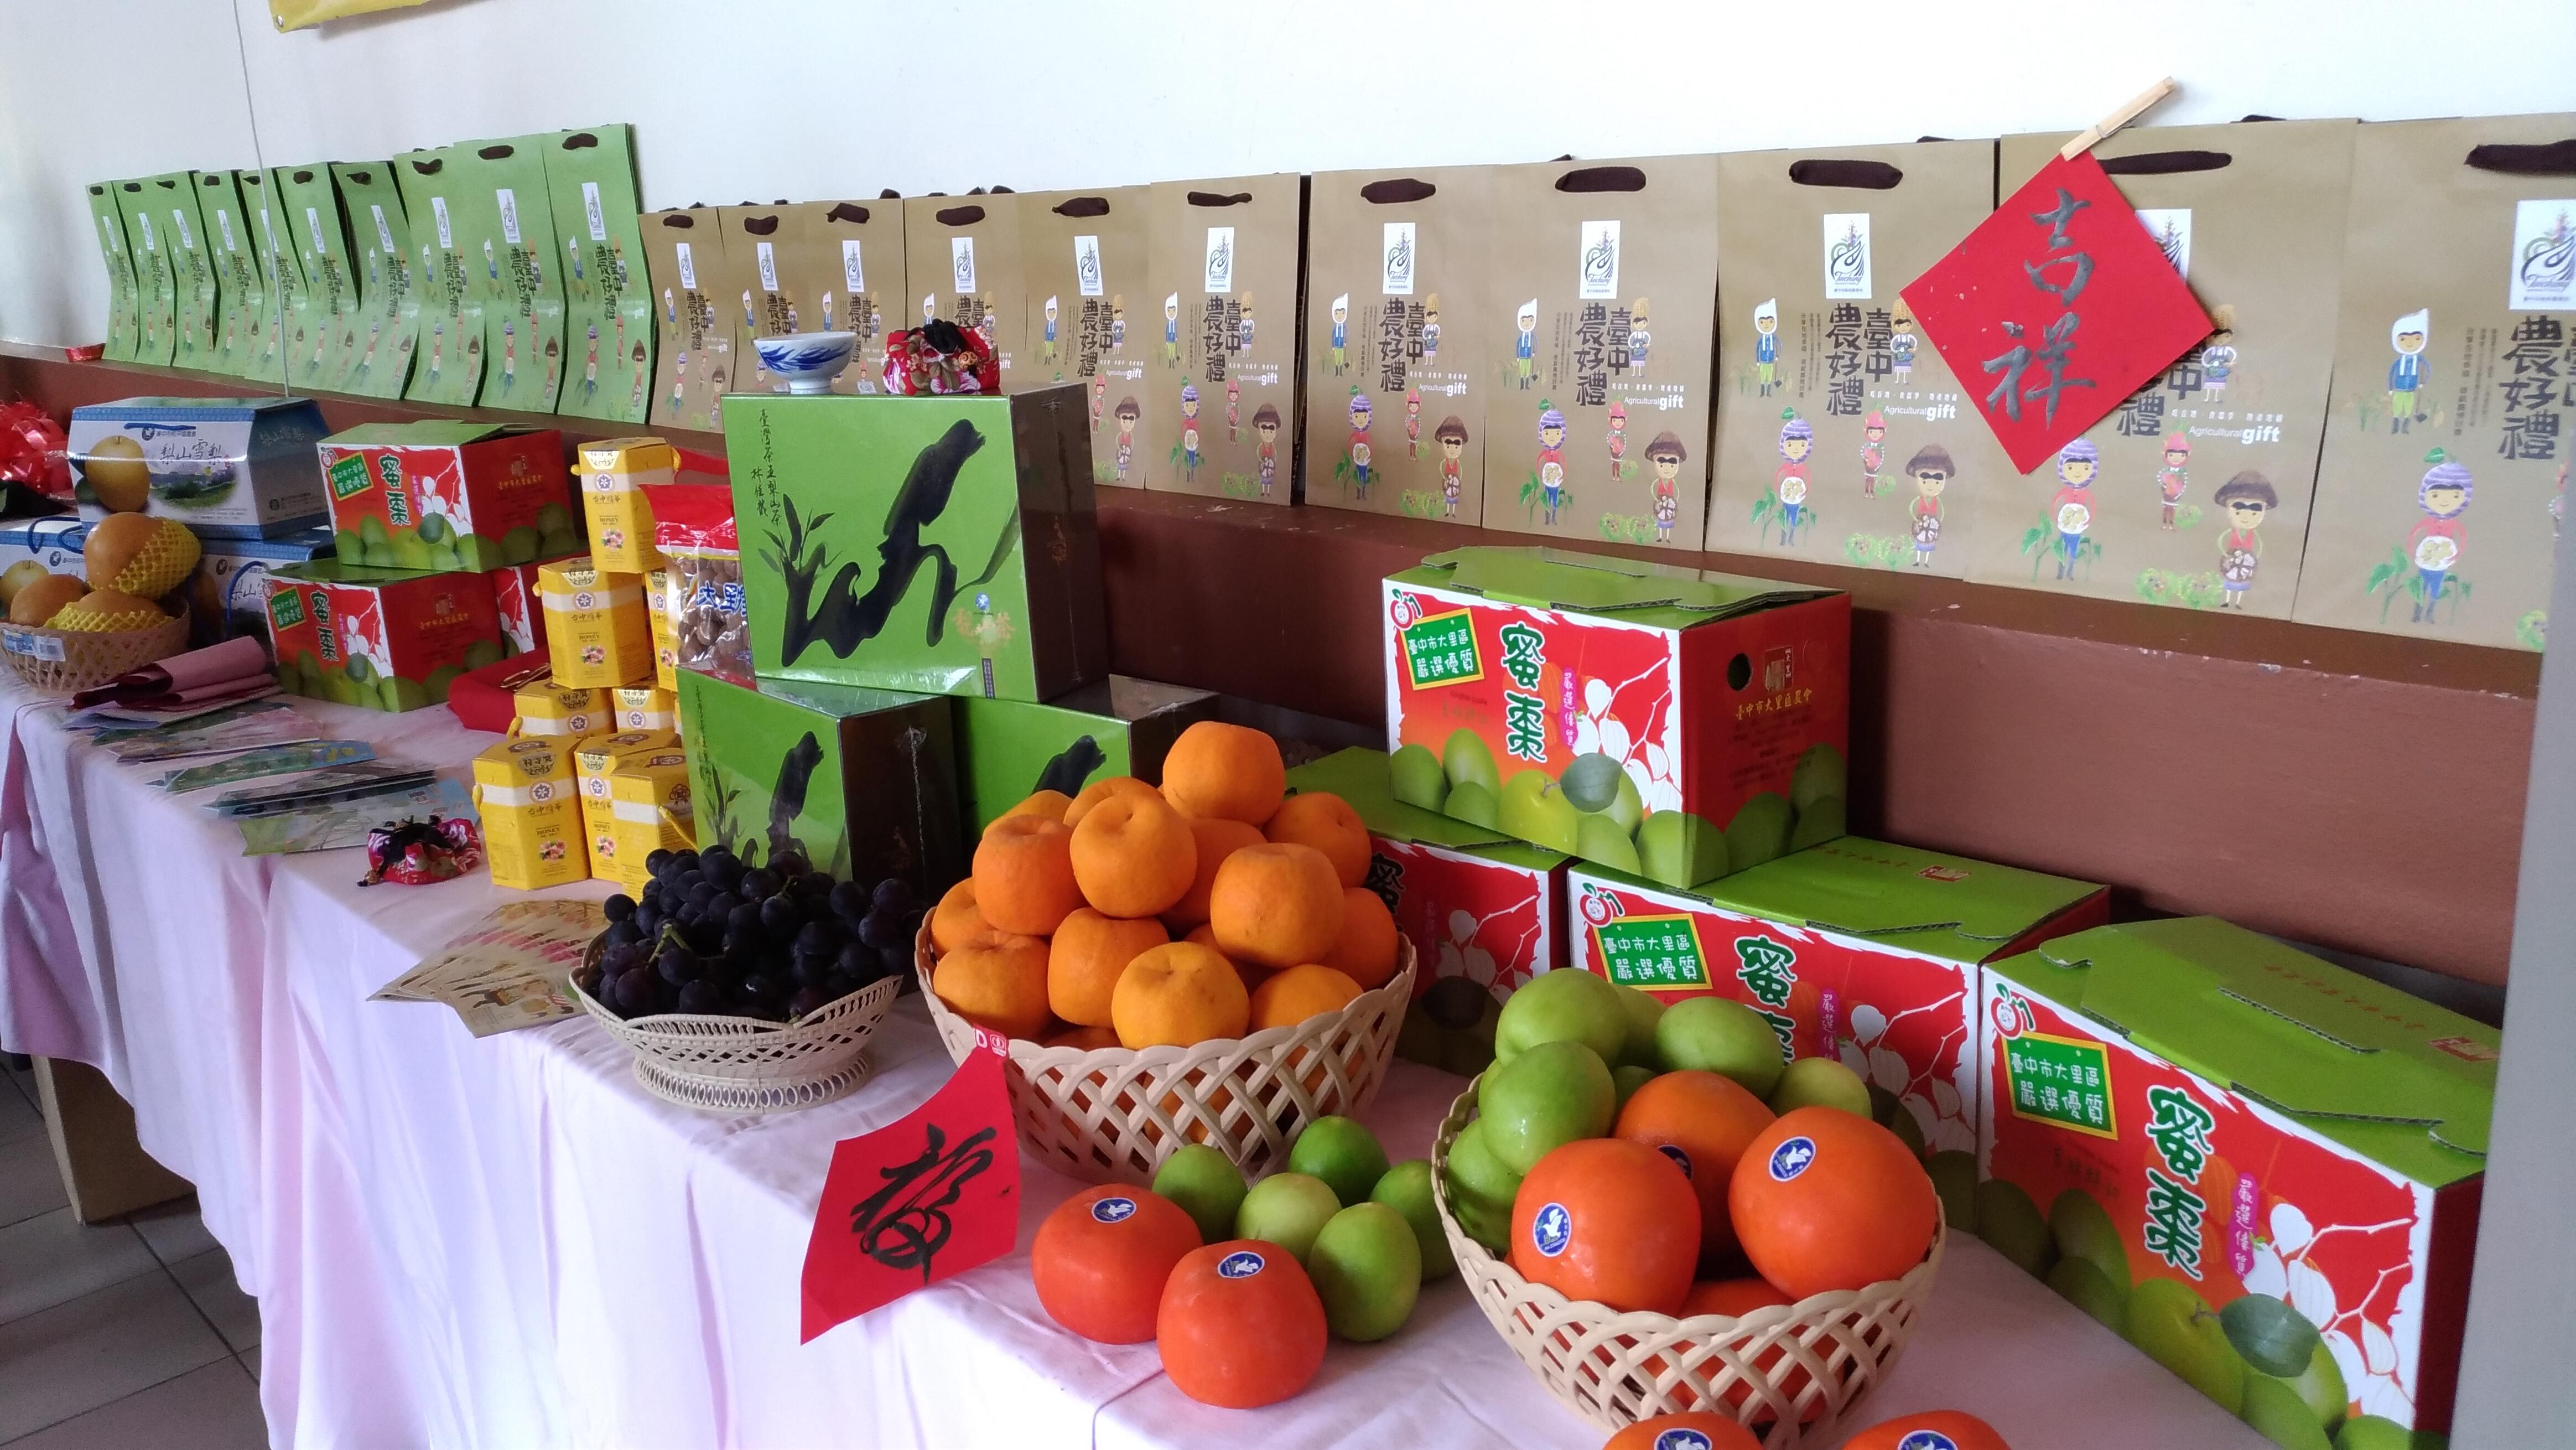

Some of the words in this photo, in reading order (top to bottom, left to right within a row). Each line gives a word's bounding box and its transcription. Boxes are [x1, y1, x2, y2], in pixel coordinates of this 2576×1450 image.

[861, 297, 872, 343] 臺中
[1077, 298, 1098, 377] 農好禮
[1099, 302, 1114, 354] 臺中
[1224, 299, 1242, 357] 臺中
[1406, 302, 1426, 365] 臺中
[1982, 188, 2096, 433] 吉祥
[1203, 296, 1225, 382] 農好禮
[1378, 297, 1406, 392] 農好禮
[1573, 302, 1607, 406] 農好禮
[1607, 307, 1632, 376] 臺中
[1825, 303, 1864, 416] 農好禮
[1864, 308, 1893, 382] 臺中
[1126, 368, 1142, 380] gift
[1419, 382, 1447, 391] Agricultural
[1447, 382, 1467, 396] gift
[2499, 315, 2563, 460] 農好禮
[1624, 396, 1659, 405] Agricultural
[1659, 395, 1684, 411] gift
[1884, 406, 1926, 415] Agricultural
[1926, 404, 1956, 421] gift
[159, 438, 222, 466] 梨山雪梨
[2188, 426, 2241, 437] Agricultural
[2241, 426, 2280, 444] gift
[378, 454, 411, 525] 蜜棗
[310, 590, 339, 661] 蜜棗
[1408, 629, 1469, 655] 臺中市大里區
[1416, 648, 1474, 678] 嚴選優質
[1500, 621, 1547, 763] 蜜棗
[1736, 688, 1812, 720] 臺中市大里區農會
[1603, 934, 1690, 954] 臺中市大里區
[1615, 955, 1697, 980] 嚴選優質
[2011, 1052, 2099, 1087] 臺中市大里區
[2020, 1080, 2103, 1125] 嚴選優質
[2147, 1085, 2214, 1281] 蜜棗
